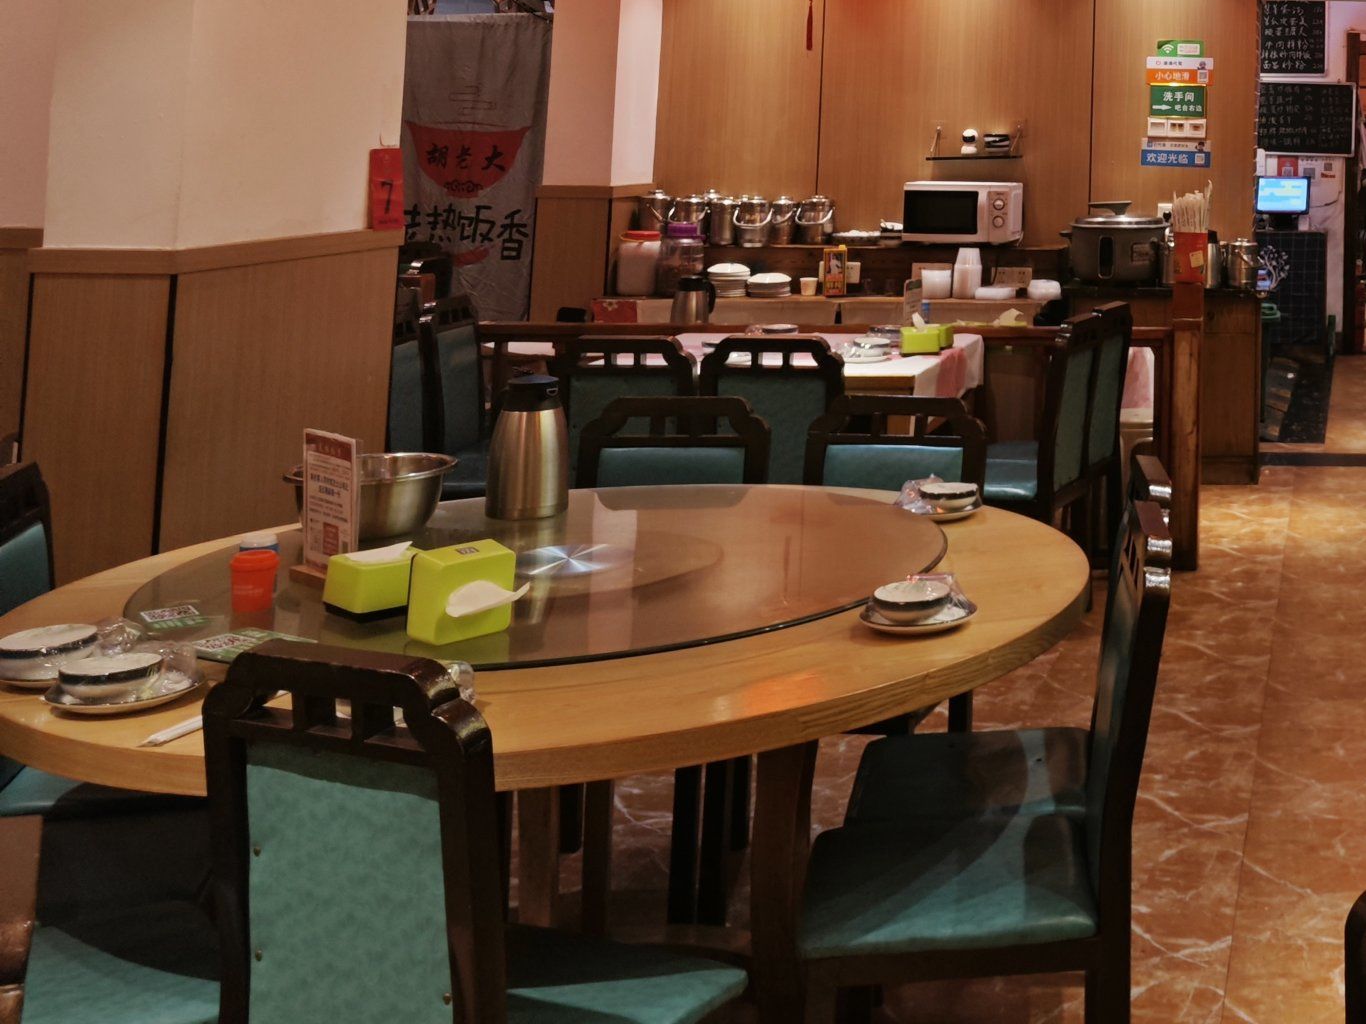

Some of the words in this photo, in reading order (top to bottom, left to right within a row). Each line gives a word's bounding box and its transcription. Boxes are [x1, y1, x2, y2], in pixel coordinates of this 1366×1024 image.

[1155, 71, 1190, 81] 小心地滑
[1163, 91, 1195, 102] 洗手间
[1146, 152, 1189, 164] 欢迎光临
